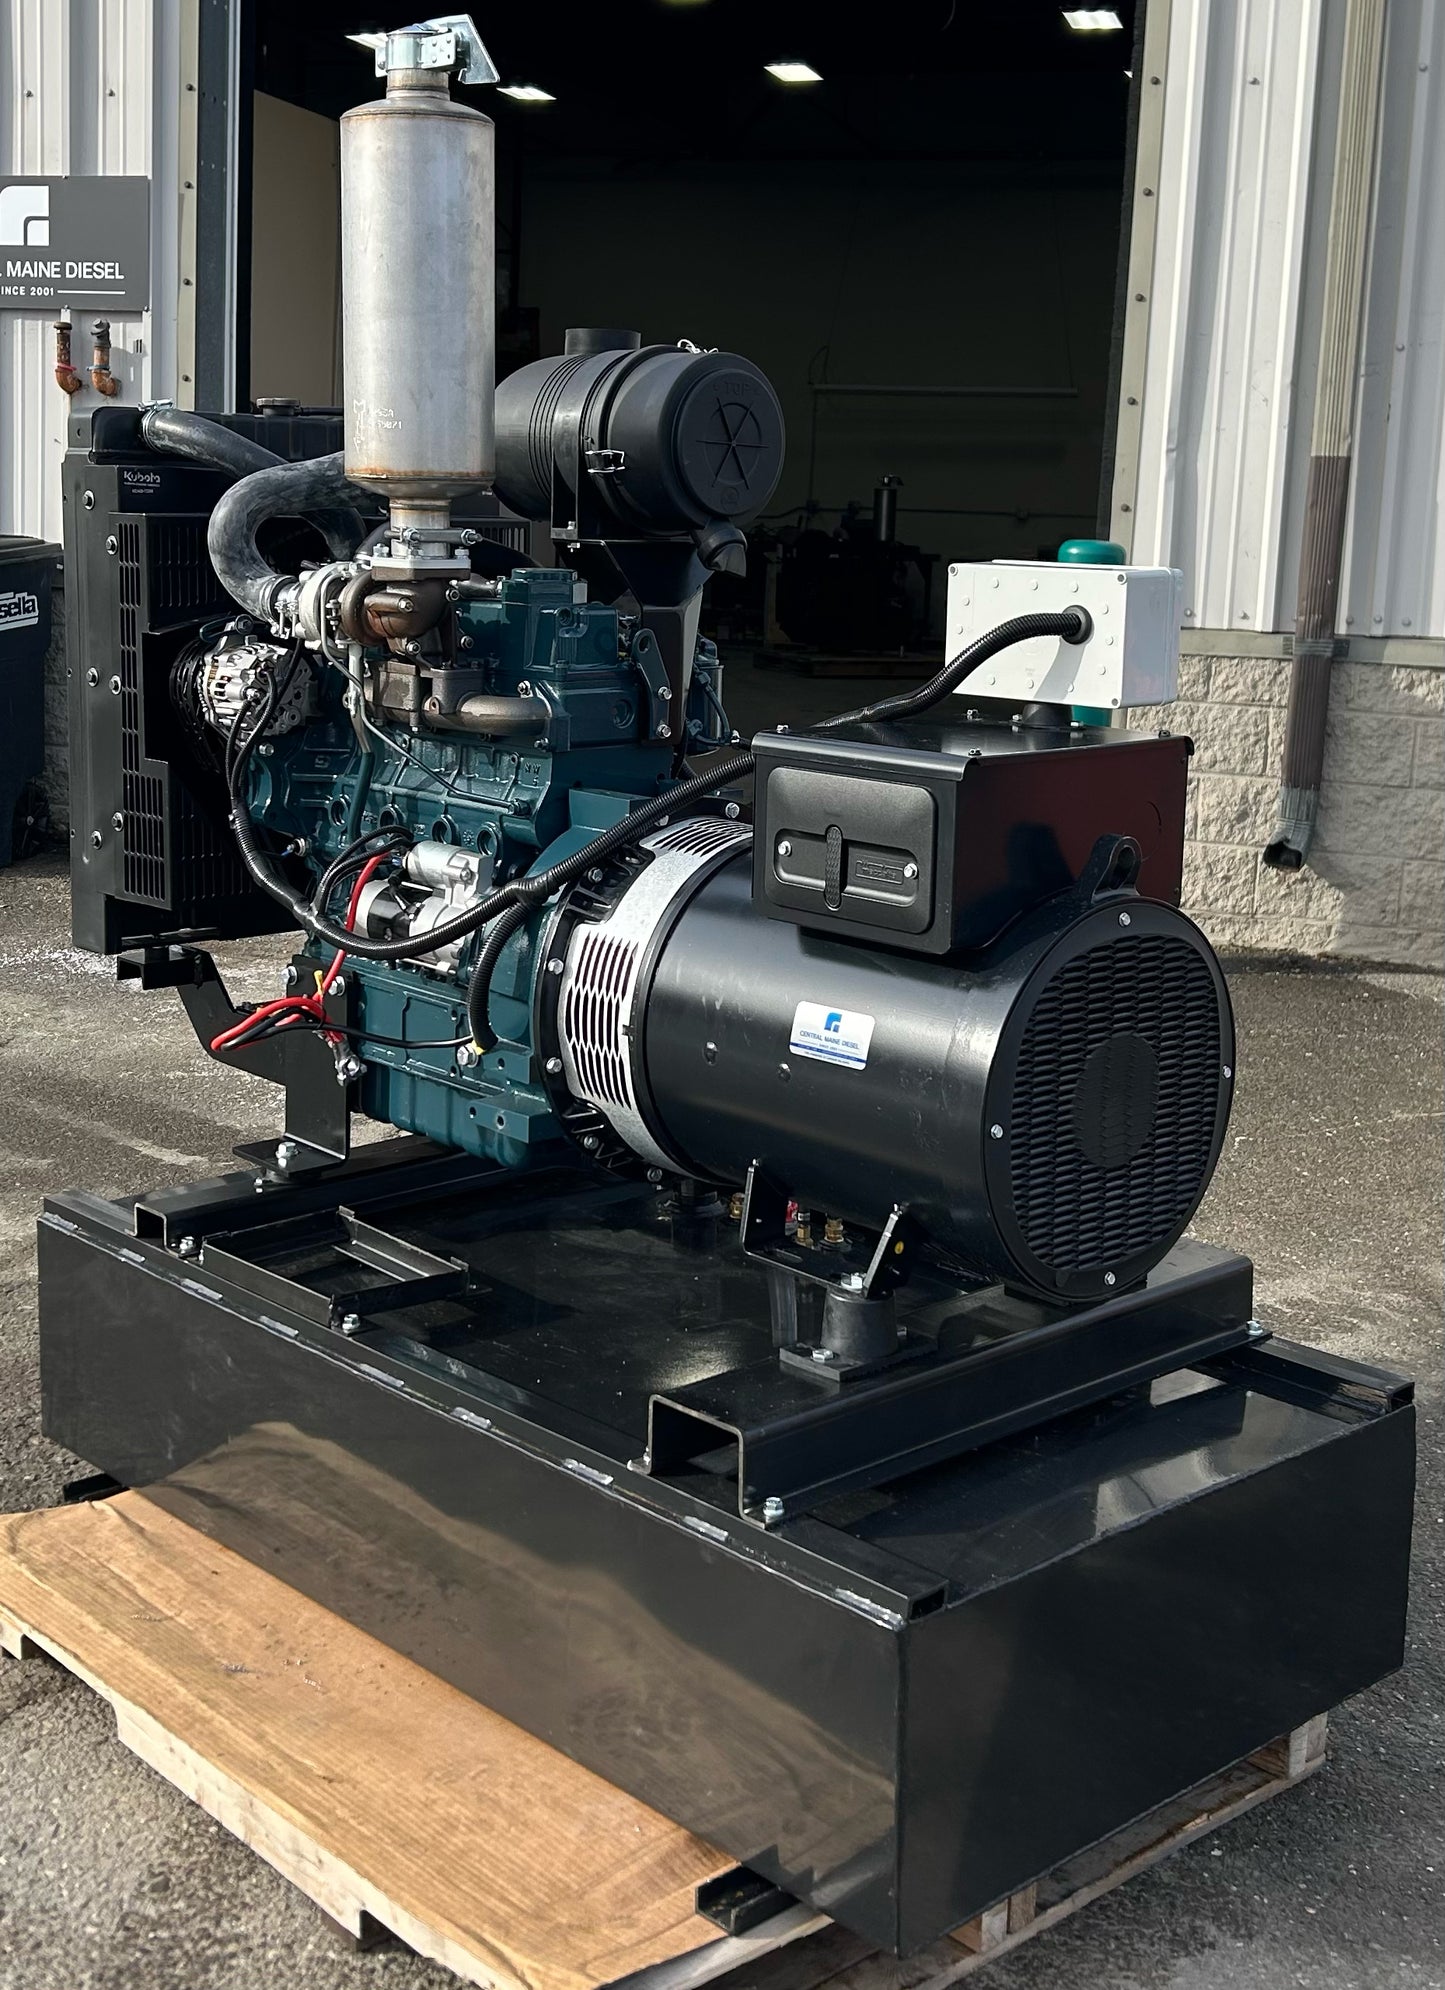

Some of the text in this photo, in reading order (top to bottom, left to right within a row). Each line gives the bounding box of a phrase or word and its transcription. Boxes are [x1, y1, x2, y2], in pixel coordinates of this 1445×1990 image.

[6, 260, 124, 279] MAINE DIESEL
[30, 286, 54, 296] 2001
[123, 470, 161, 483] Kubota
[799, 1030, 823, 1042] CENTRAL
